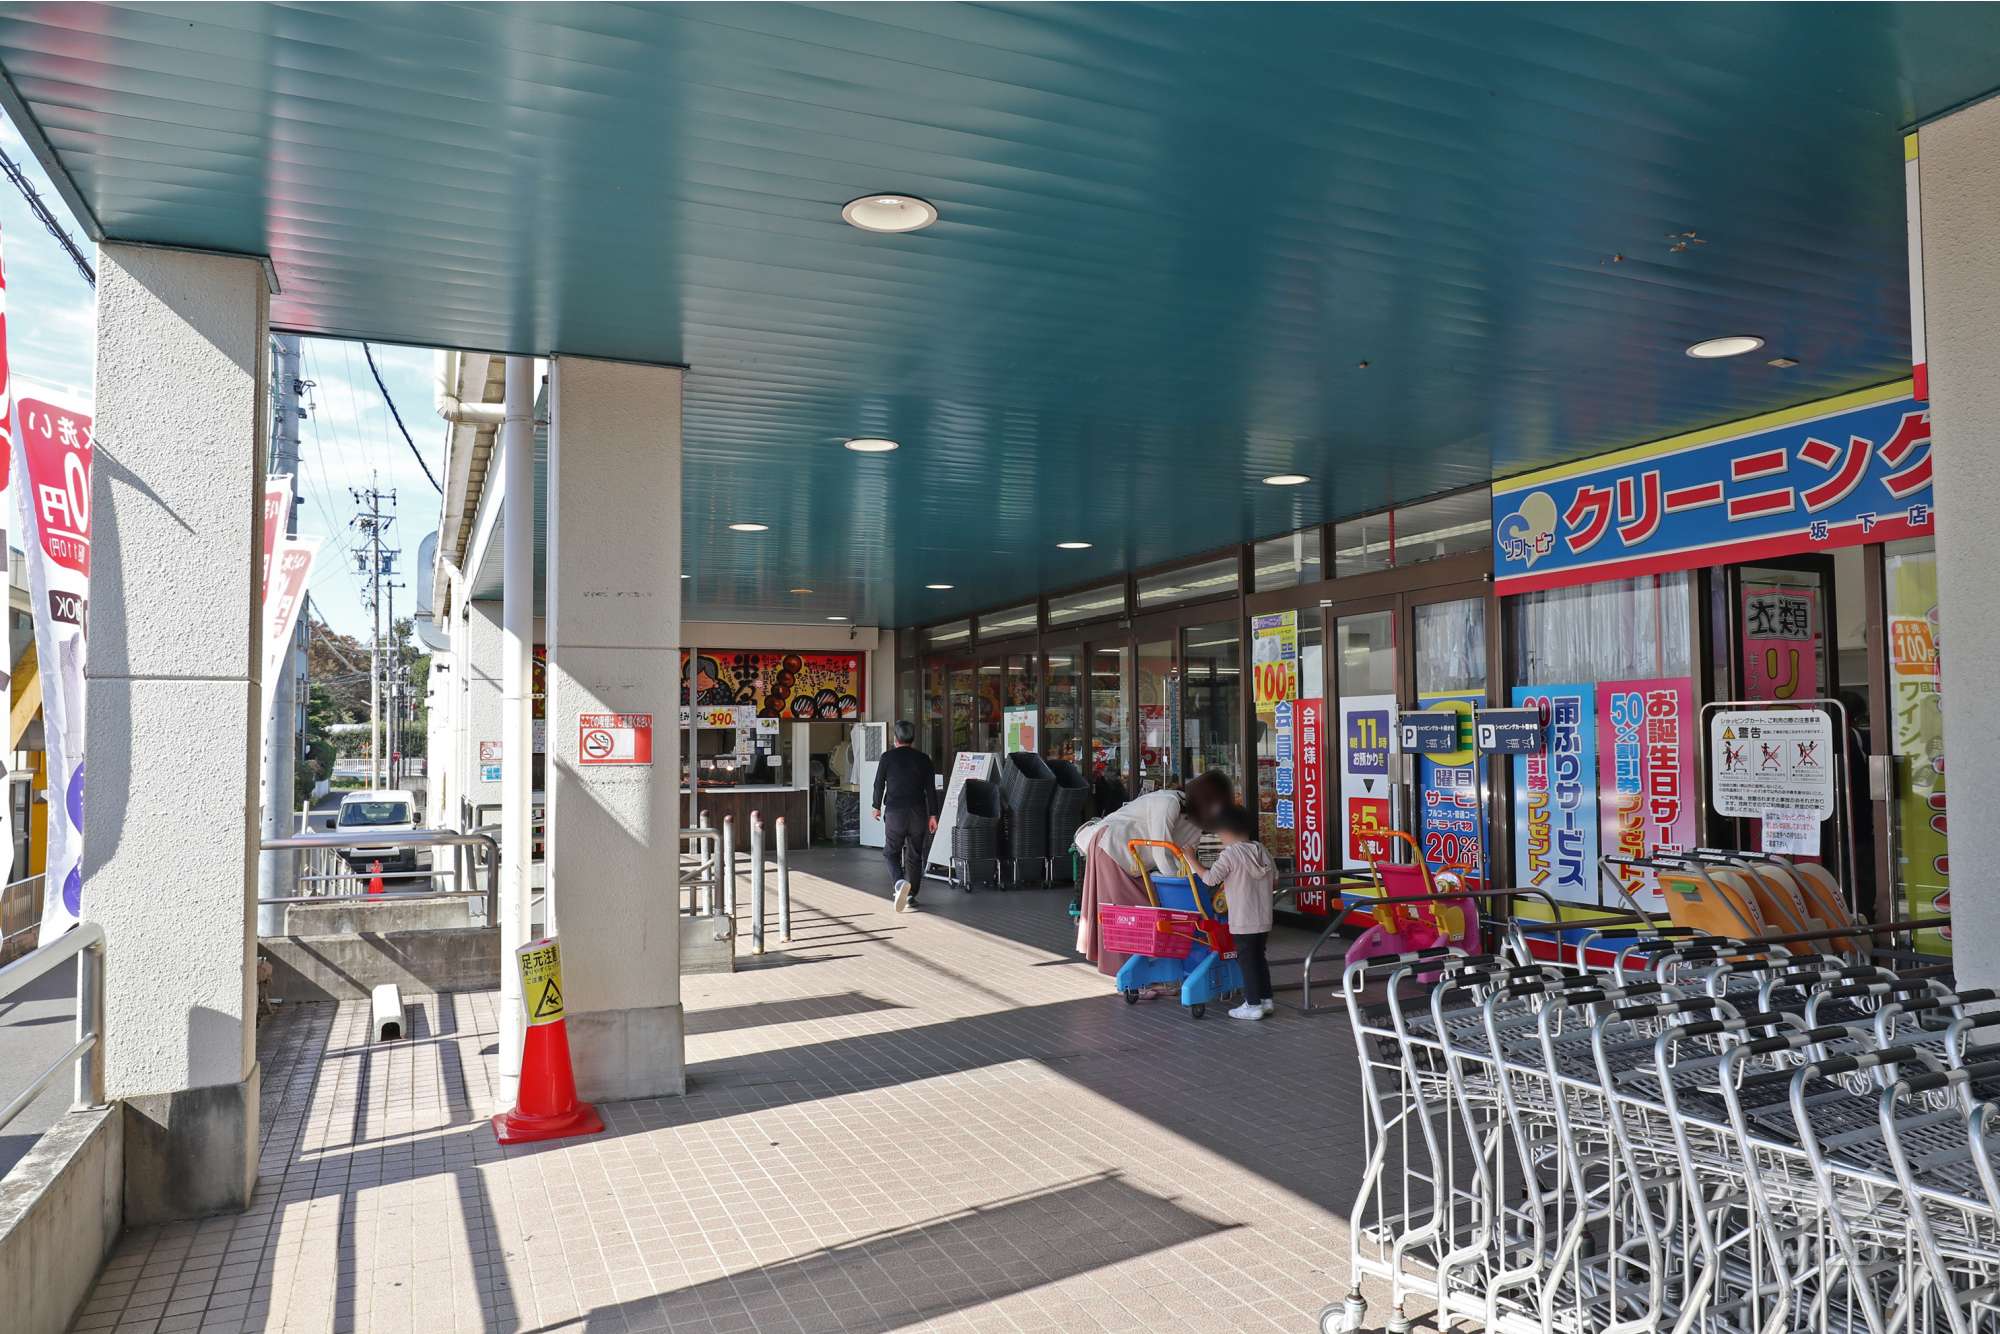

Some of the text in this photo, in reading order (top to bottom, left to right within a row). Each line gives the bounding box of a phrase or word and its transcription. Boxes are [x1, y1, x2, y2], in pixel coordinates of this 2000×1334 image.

[1810, 503, 1929, 541] 坂下店
[1749, 599, 1808, 636] 衣類
[1405, 728, 1414, 745] P
[1482, 728, 1491, 745] P
[1738, 727, 1761, 738] 警告
[1274, 700, 1294, 830] 会員募集
[1434, 768, 1474, 788] 曜日
[1553, 696, 1584, 891] 雨ふりサービス
